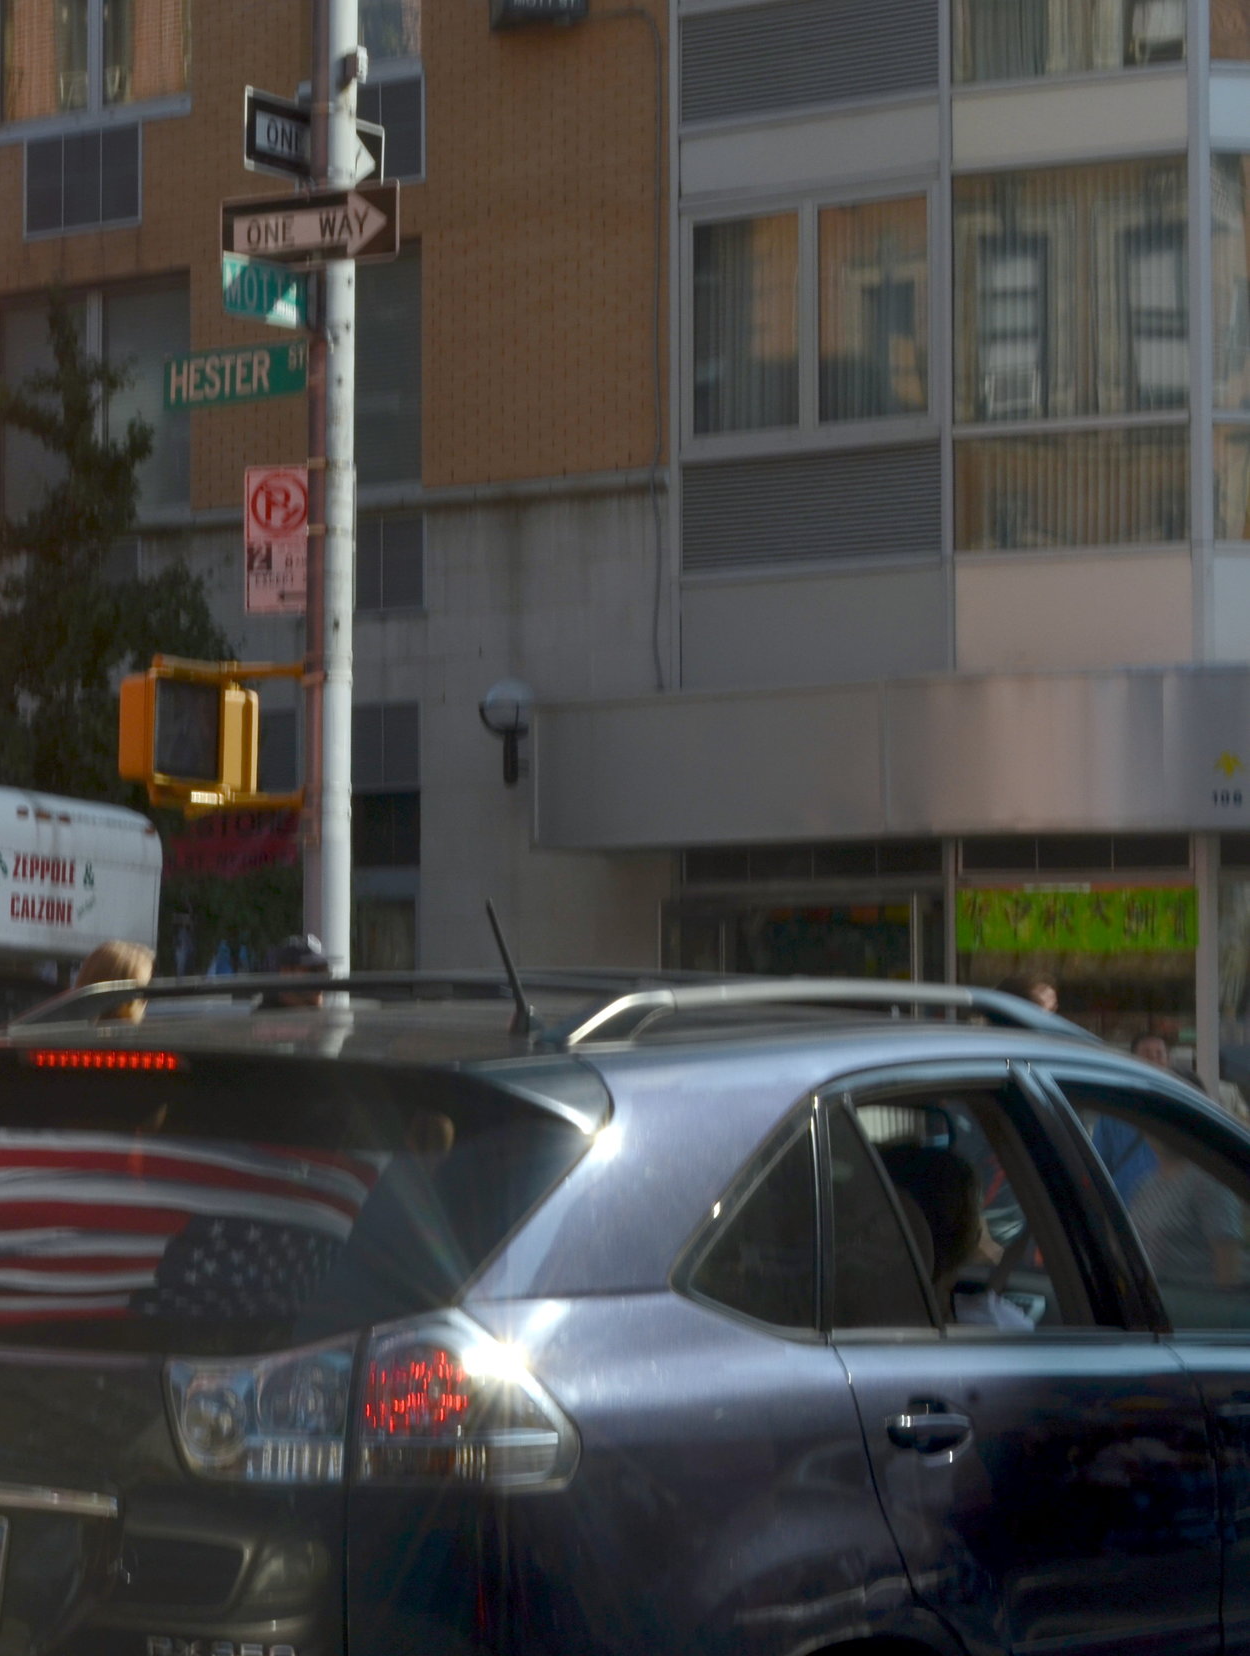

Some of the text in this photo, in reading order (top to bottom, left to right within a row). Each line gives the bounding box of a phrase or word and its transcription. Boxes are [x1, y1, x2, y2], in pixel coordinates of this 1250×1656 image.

[246, 205, 371, 248] ONE WAY
[225, 262, 285, 313] MOTT
[169, 350, 271, 405] HESTER
[12, 851, 75, 889] ZEPPOLE
[83, 859, 95, 890] &
[10, 892, 73, 927] CALZONE
